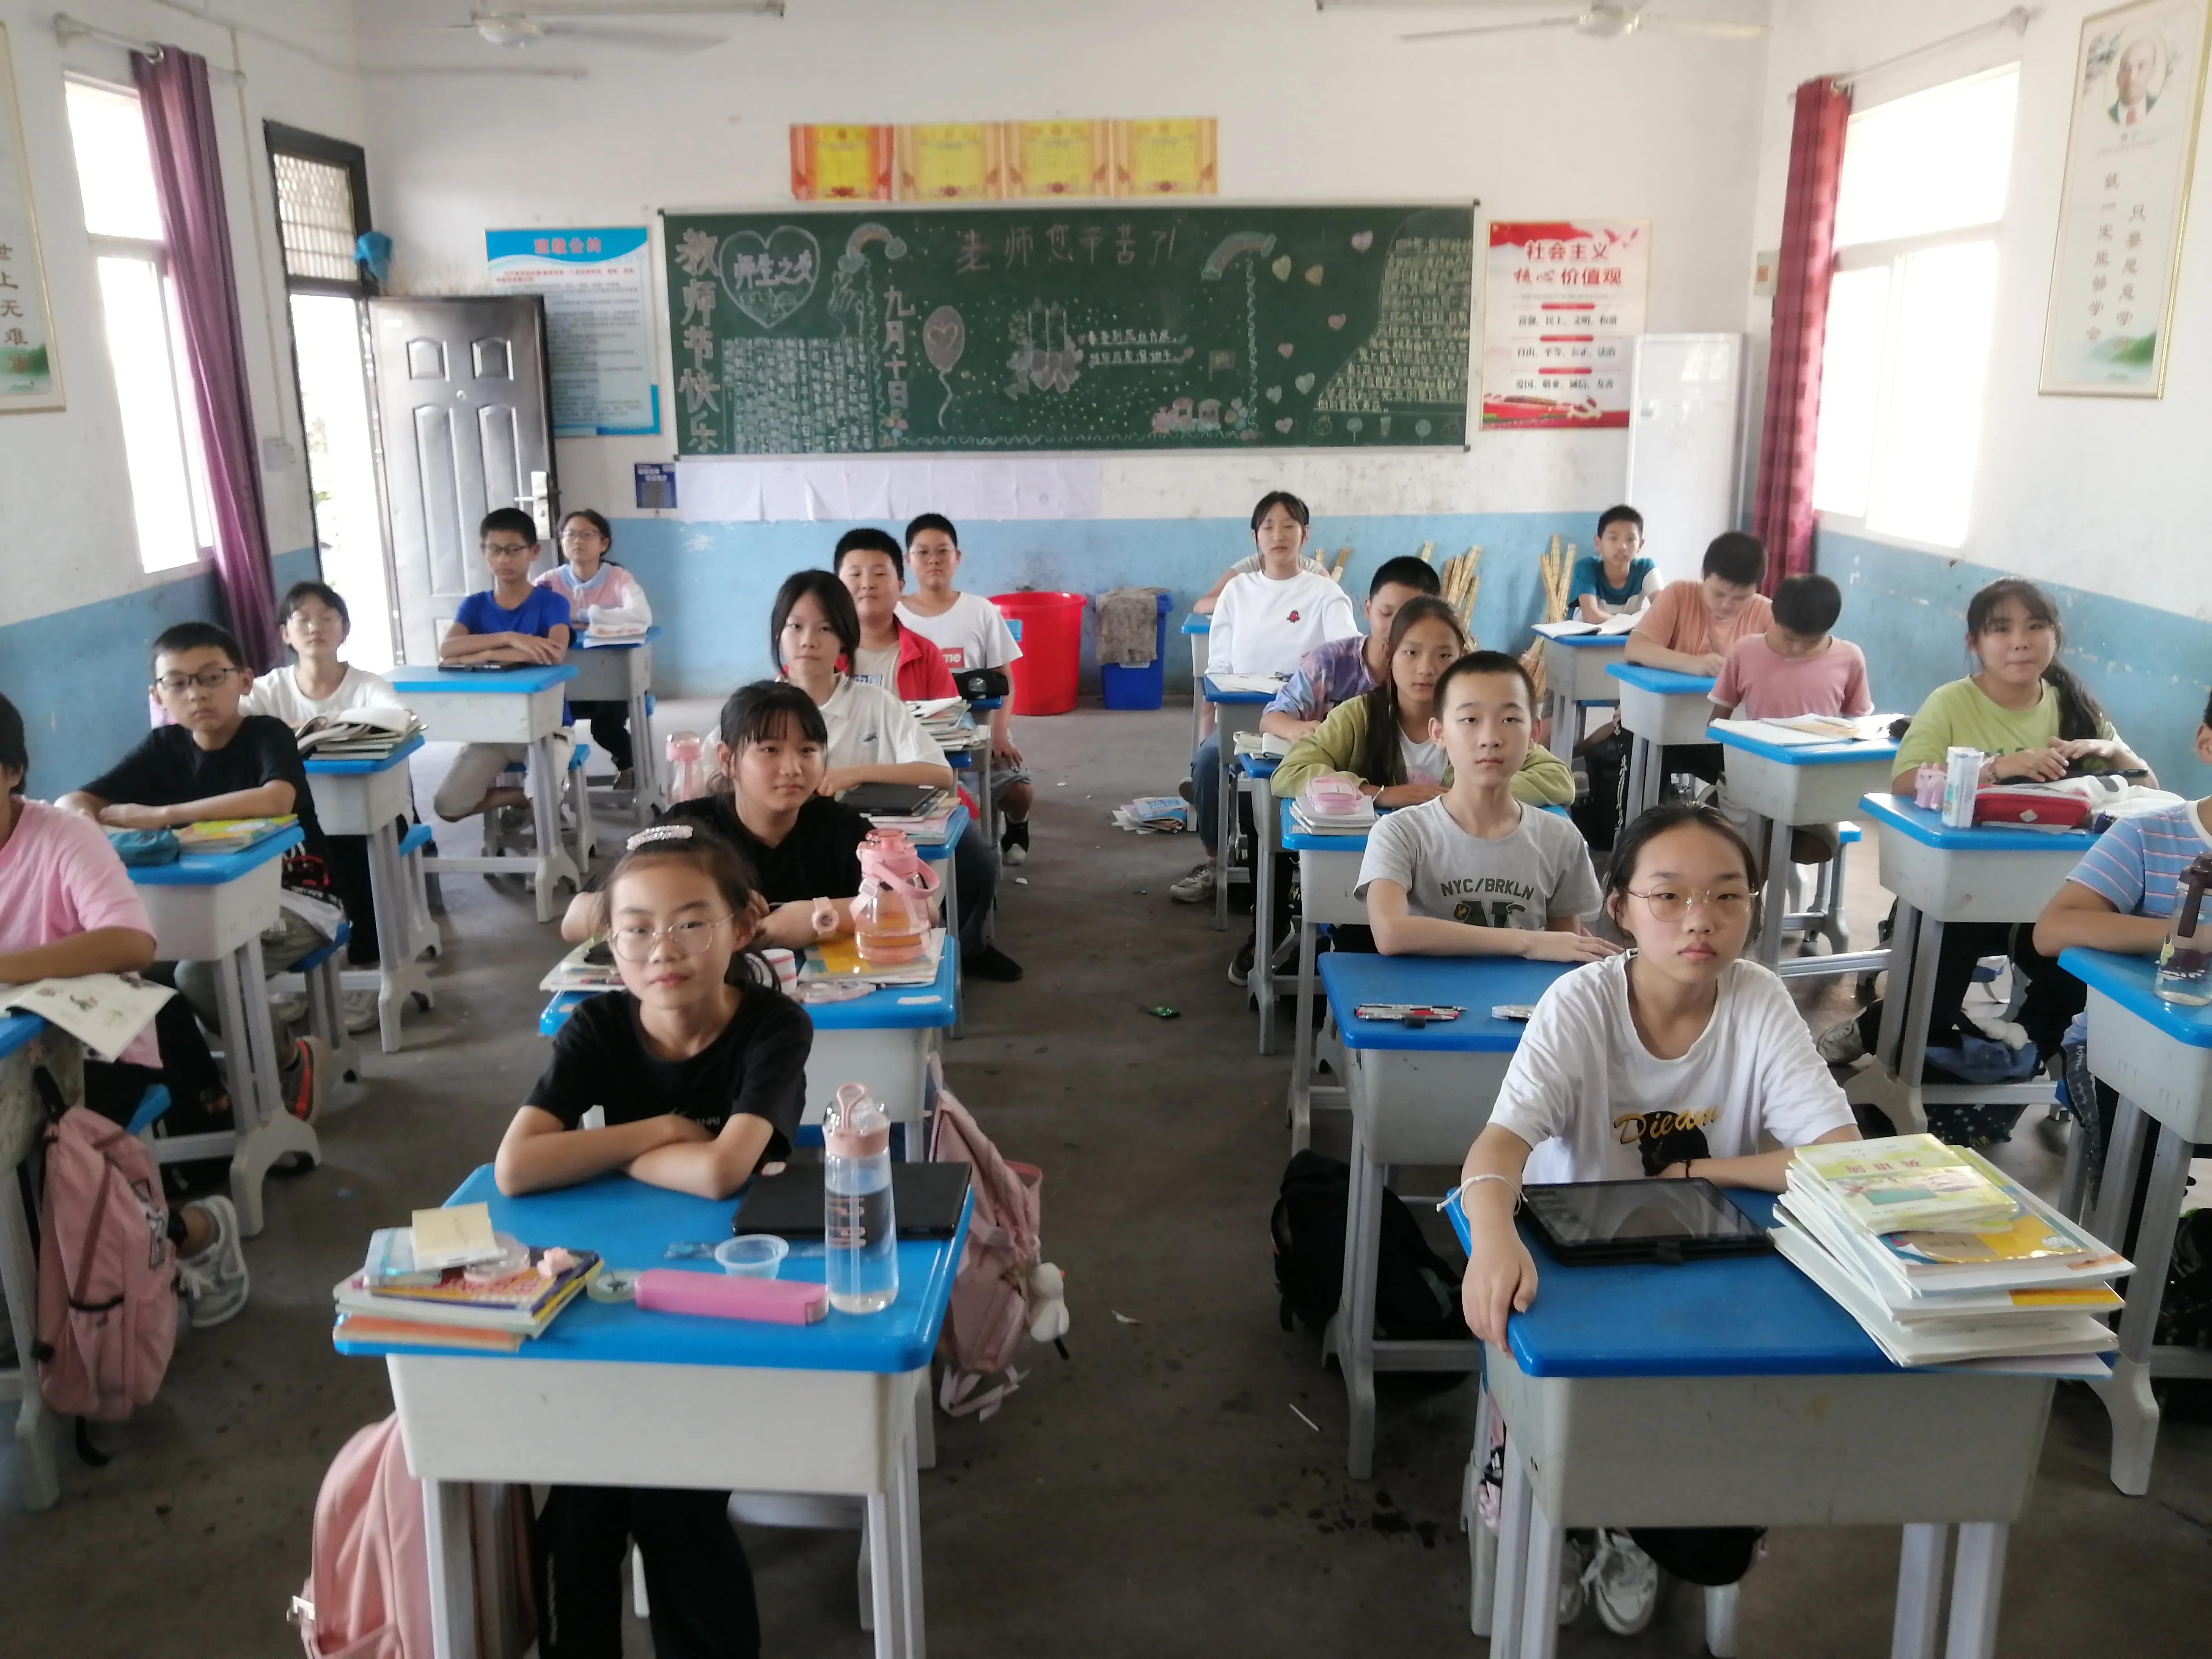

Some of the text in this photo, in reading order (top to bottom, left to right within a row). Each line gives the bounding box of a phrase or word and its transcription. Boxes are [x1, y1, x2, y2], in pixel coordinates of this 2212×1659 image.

[1527, 241, 1608, 260] 社会主义
[1514, 267, 1621, 285] 核心价值观
[675, 228, 721, 452] 教师节快乐
[882, 285, 916, 408] 九月十日
[1441, 877, 1534, 900] NYC/BRKLN
